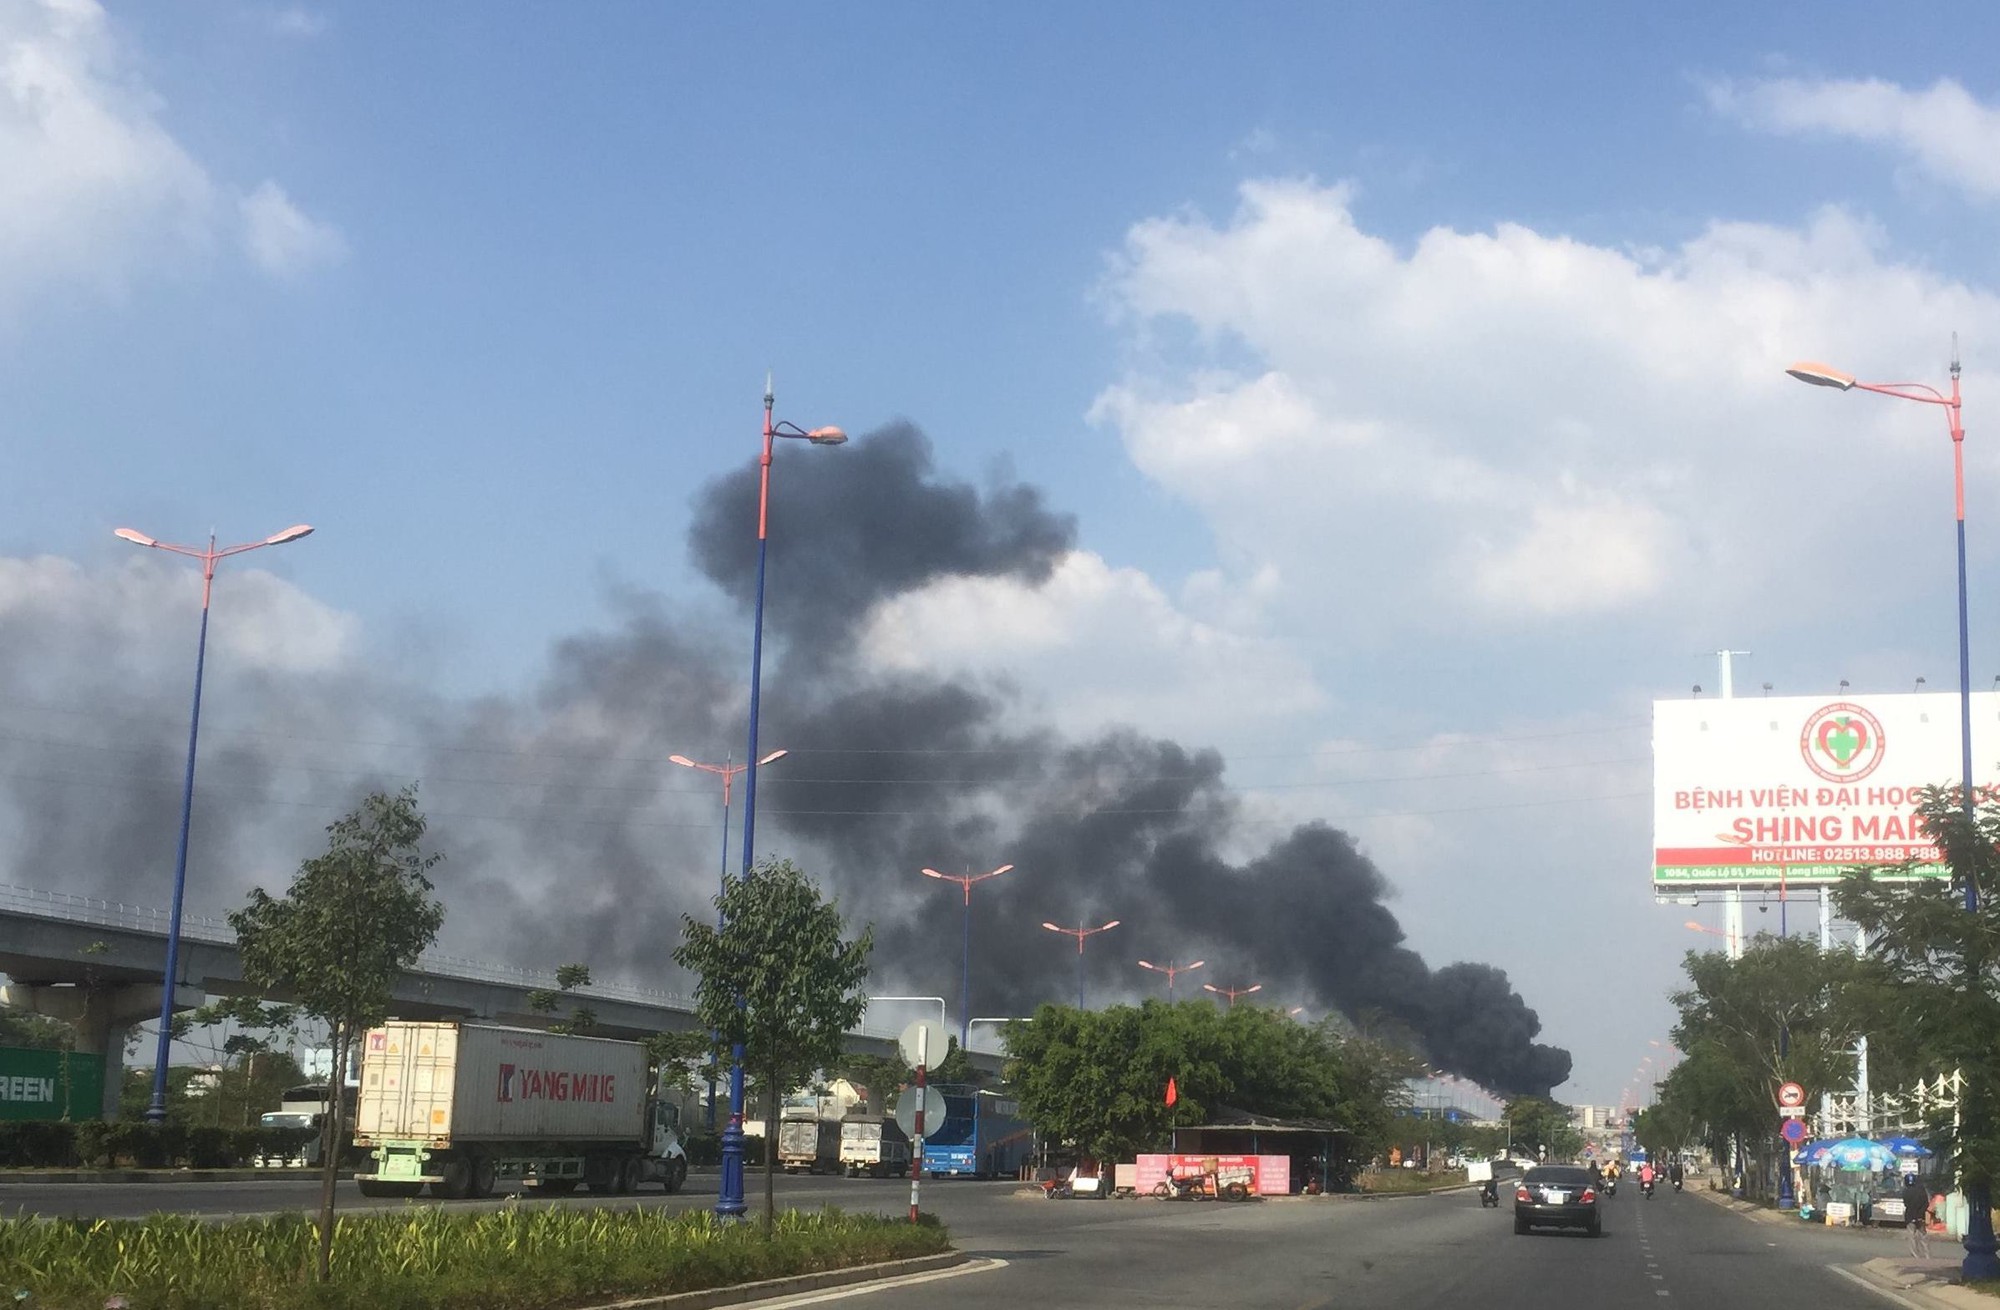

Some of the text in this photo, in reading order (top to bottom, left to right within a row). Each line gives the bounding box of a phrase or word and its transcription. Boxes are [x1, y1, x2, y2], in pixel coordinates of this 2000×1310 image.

[1675, 786, 1743, 813] BỆNH
[1750, 785, 1809, 811] VIỆN
[1815, 787, 1860, 811] ĐẠI
[1732, 815, 1842, 842] SHING
[1751, 848, 1821, 862] HOTLINE:
[1786, 866, 1811, 877] Long
[1812, 865, 1836, 876] Bình
[520, 1069, 569, 1101] YANG
